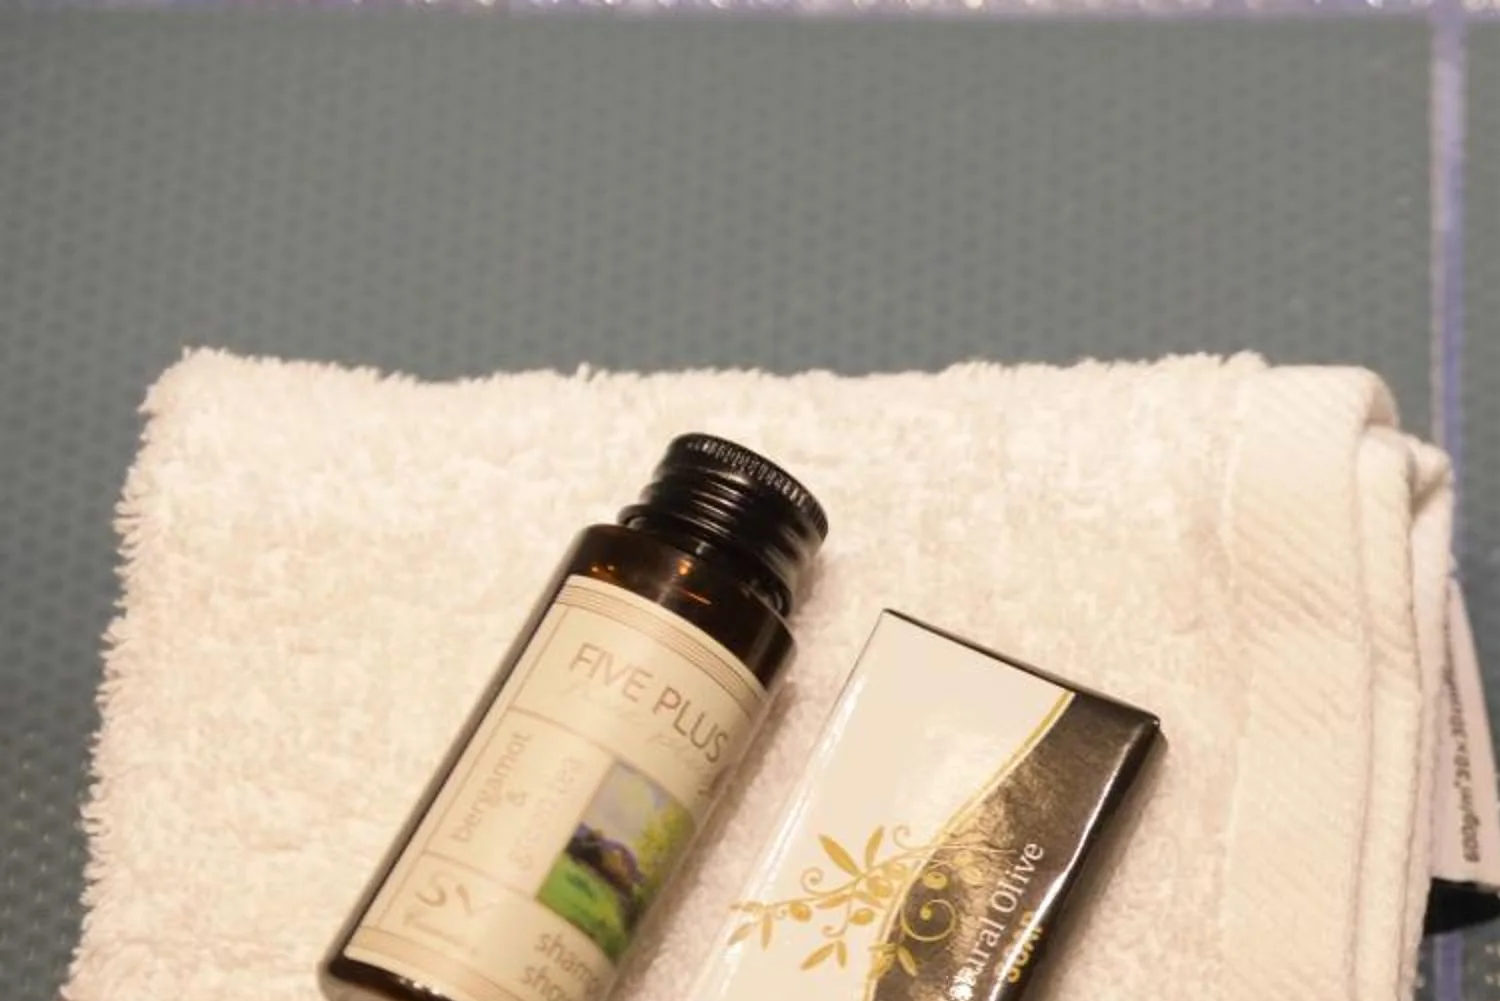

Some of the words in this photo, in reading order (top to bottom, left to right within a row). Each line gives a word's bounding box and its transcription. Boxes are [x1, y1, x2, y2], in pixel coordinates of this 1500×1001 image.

[569, 642, 654, 703] FIVE
[652, 685, 728, 763] PLUS
[448, 730, 535, 843] bergamot
[991, 842, 1045, 914] Olive
